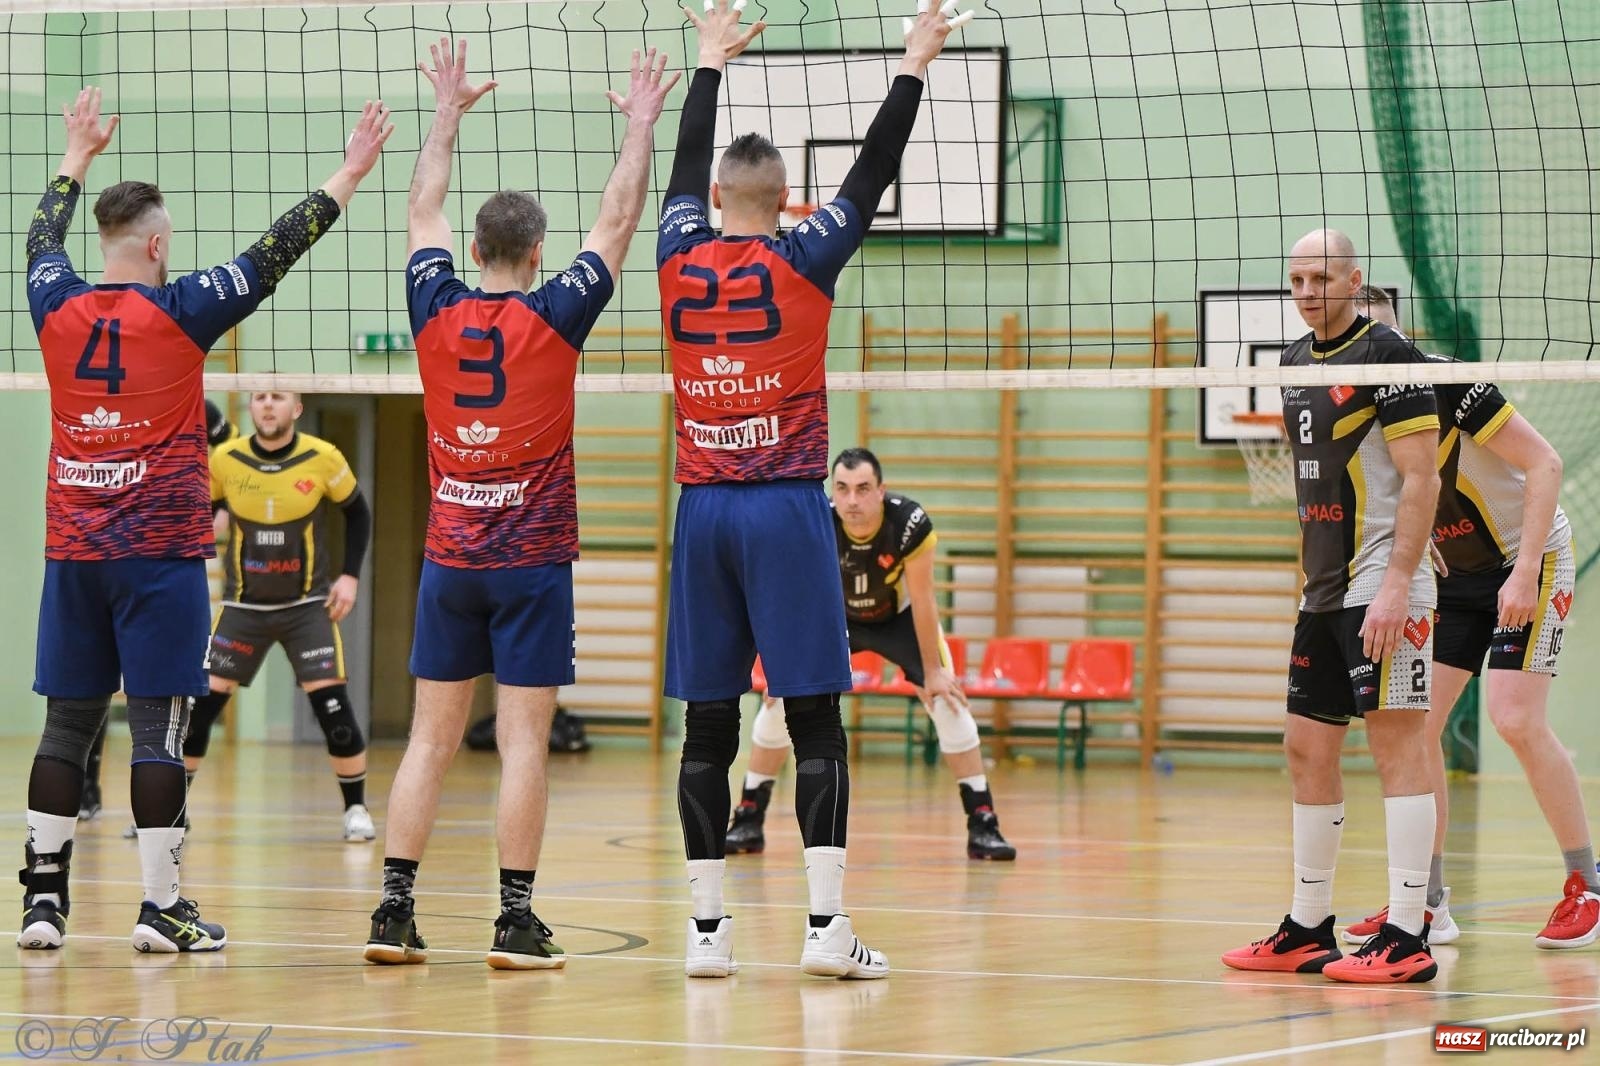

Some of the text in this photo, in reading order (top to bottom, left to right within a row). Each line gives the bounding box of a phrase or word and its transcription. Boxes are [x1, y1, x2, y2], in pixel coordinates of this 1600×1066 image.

[670, 262, 783, 345] 23
[75, 318, 126, 395] 4
[454, 326, 507, 409] 3
[680, 372, 782, 398] KATOLIK
[1299, 410, 1312, 444] 2
[256, 530, 285, 545] ENTER
[1406, 621, 1423, 641] Enter
[1411, 658, 1426, 693] 2
